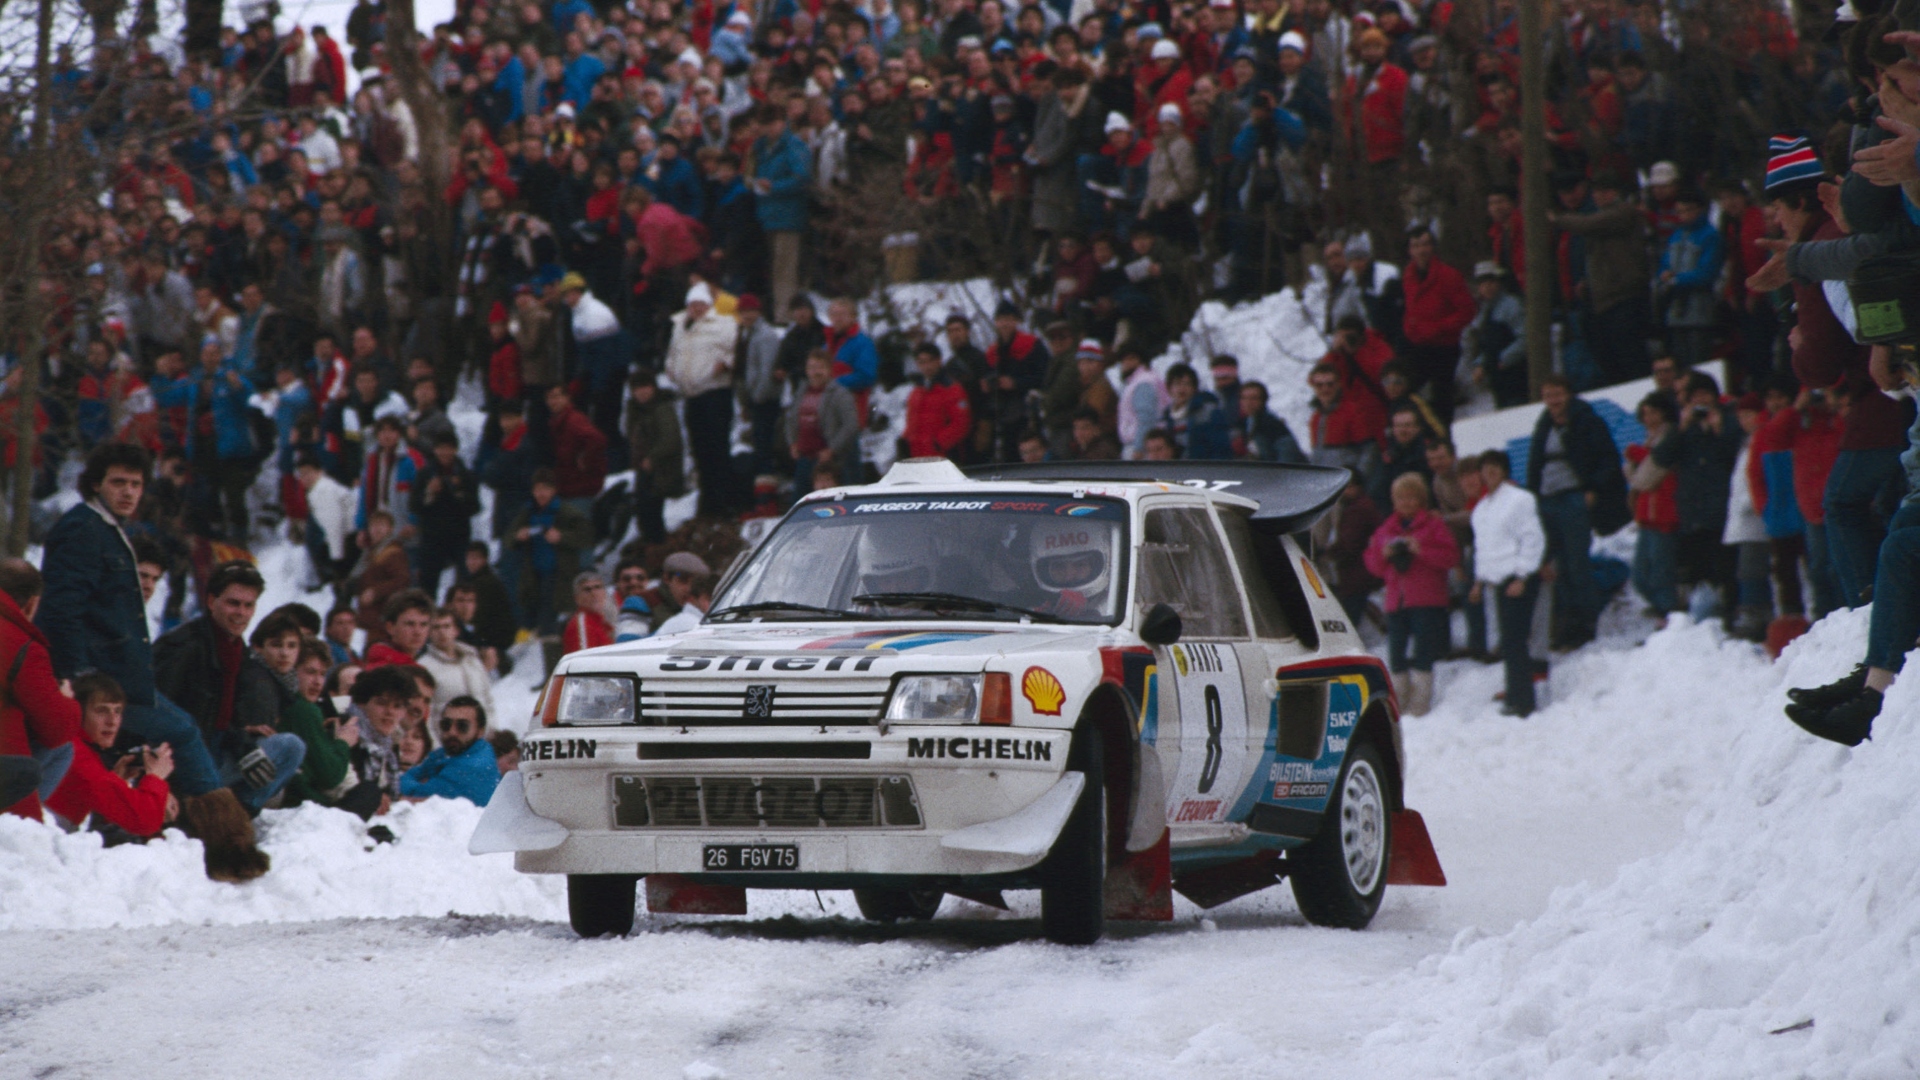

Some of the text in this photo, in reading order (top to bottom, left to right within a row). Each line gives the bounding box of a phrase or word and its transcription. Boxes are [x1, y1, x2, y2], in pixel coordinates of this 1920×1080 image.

[853, 501, 1048, 513] PEUGEOT TALBOT SPORT
[1185, 643, 1223, 672] PARIS
[1329, 711, 1357, 728] SKF
[522, 738, 597, 761] HELIN
[907, 737, 1052, 761] MICHELIN
[1198, 684, 1223, 794] 8
[1269, 762, 1314, 782] BILSTEIN
[1290, 784, 1328, 796] FACOM
[653, 785, 874, 821] PEUGEOT
[707, 848, 796, 867] 26 FGV 75
